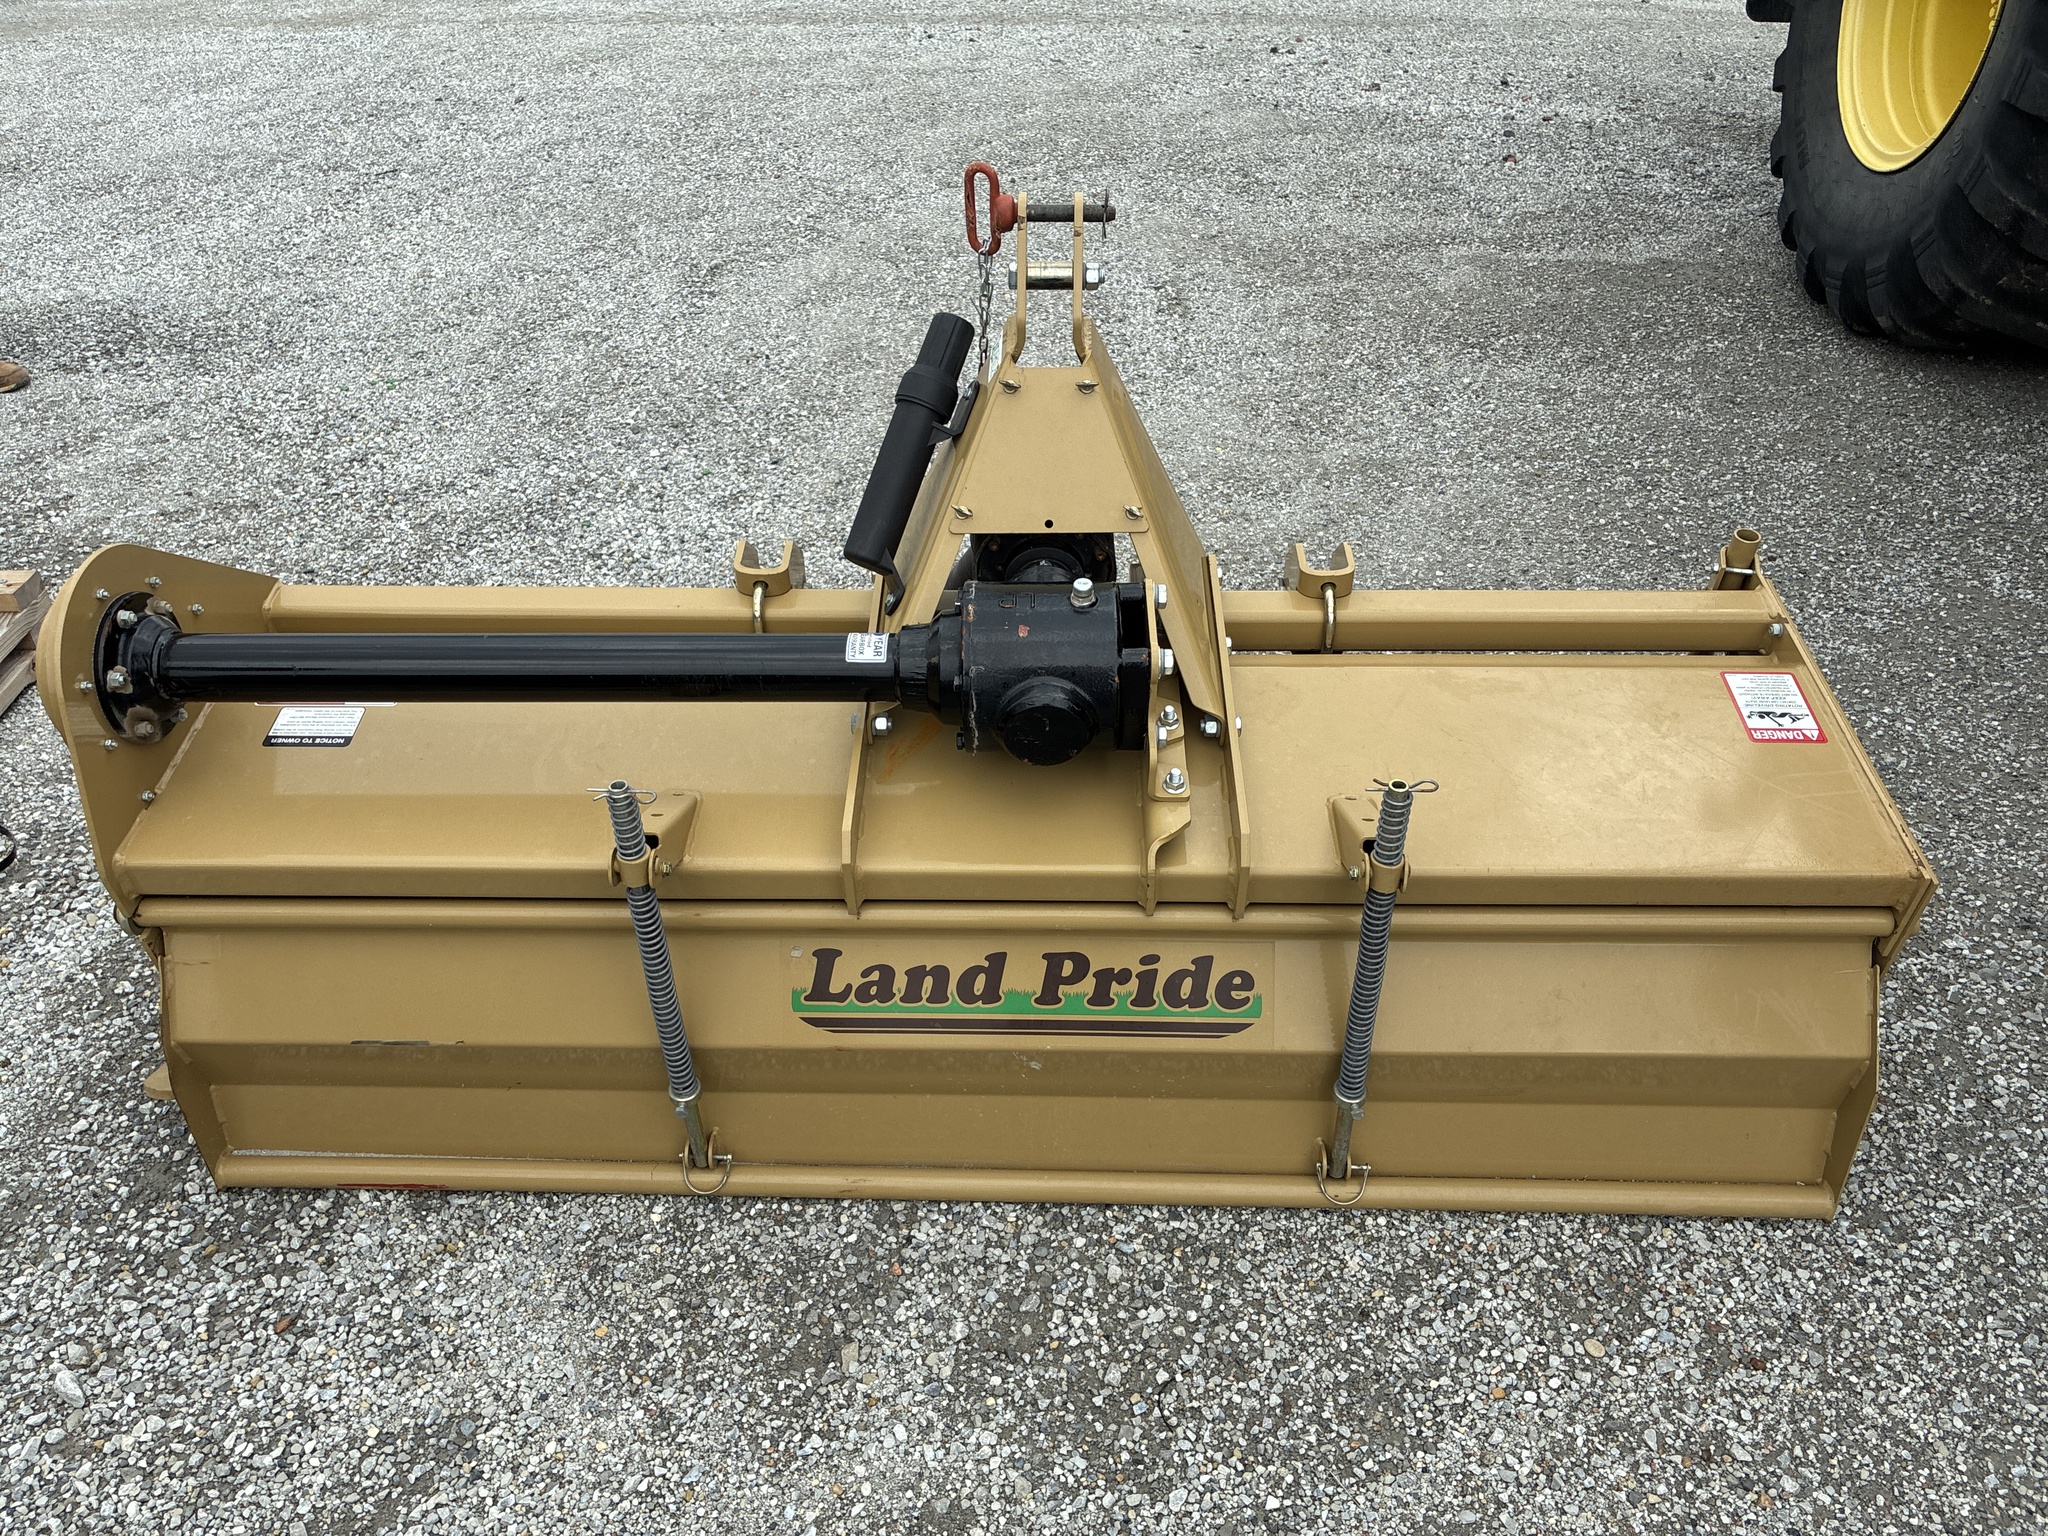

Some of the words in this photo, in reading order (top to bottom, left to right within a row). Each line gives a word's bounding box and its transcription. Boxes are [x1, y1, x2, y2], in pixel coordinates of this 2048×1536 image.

[858, 633, 866, 656] EARBOX
[873, 636, 884, 657] YEAR
[1751, 729, 1804, 740] DANGER
[803, 947, 1008, 1006] Land
[1031, 951, 1256, 1010] Pride
